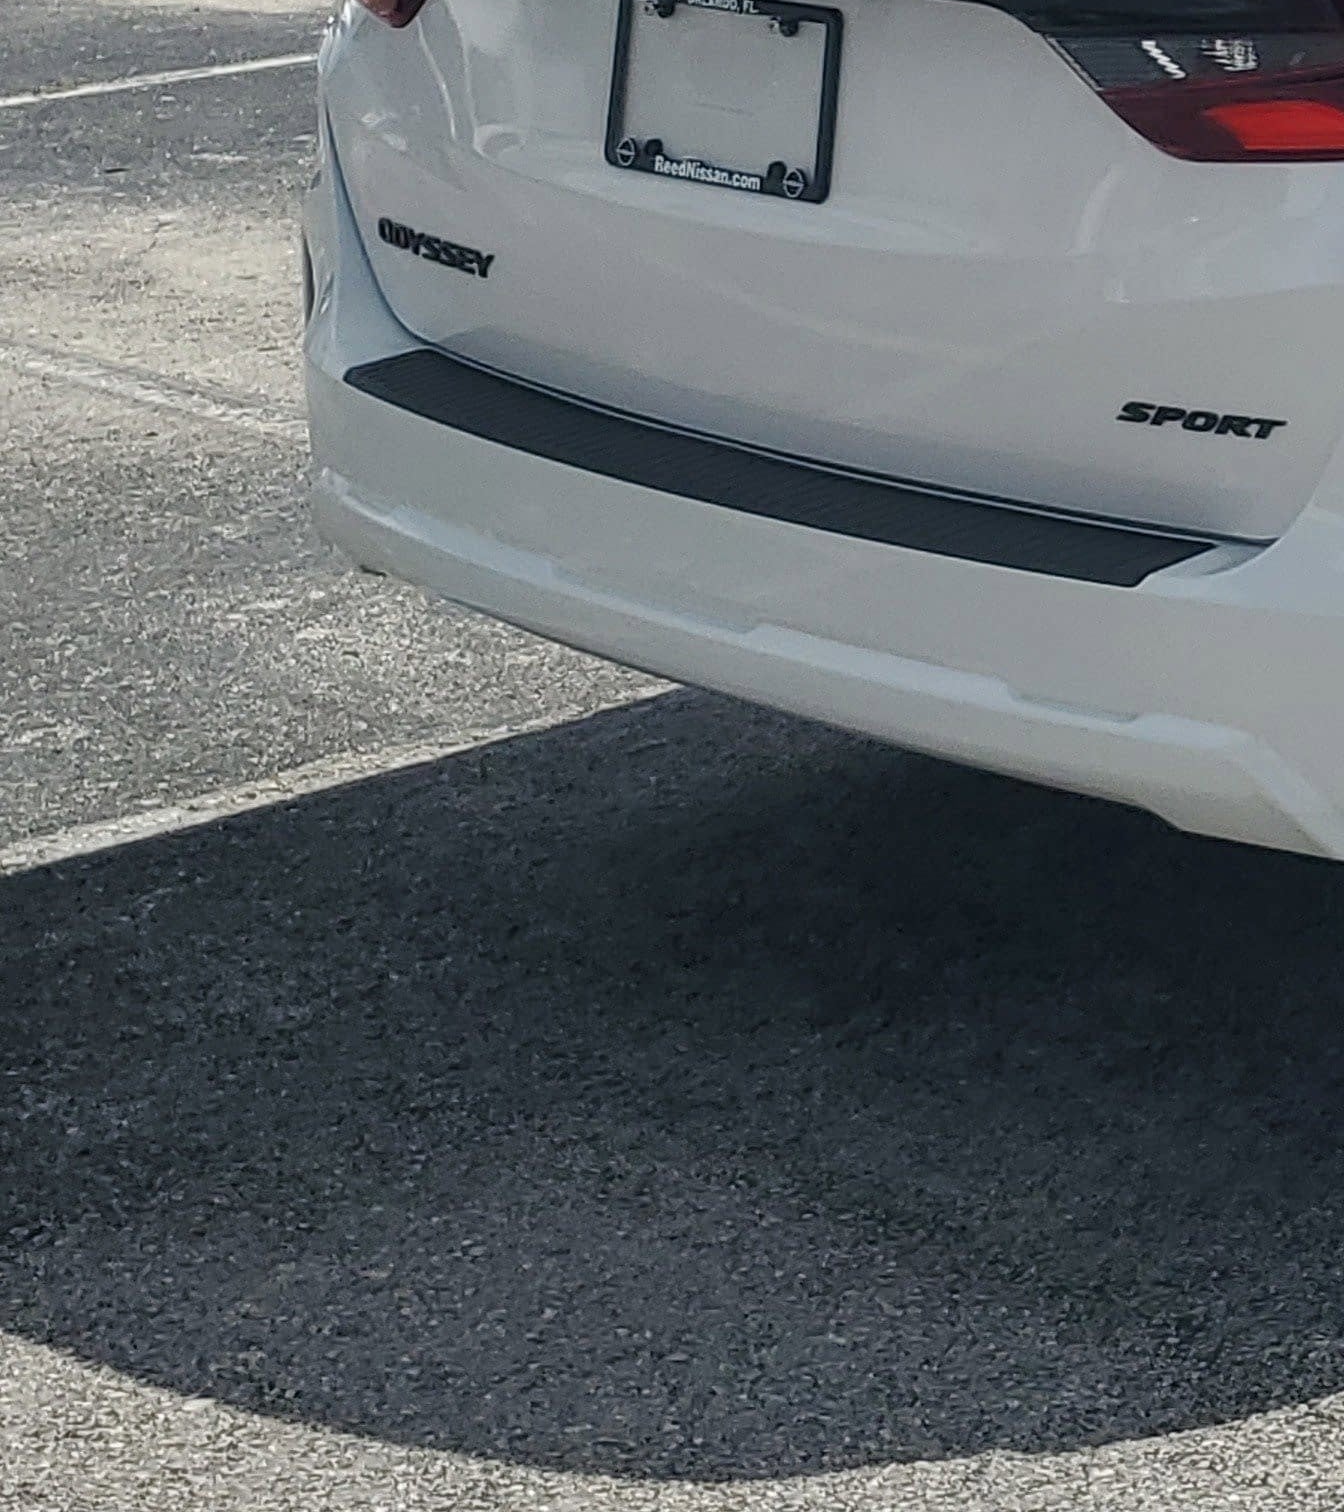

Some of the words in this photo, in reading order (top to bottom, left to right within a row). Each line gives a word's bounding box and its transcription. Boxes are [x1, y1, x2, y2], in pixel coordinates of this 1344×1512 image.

[742, 0, 760, 14] FL
[653, 154, 761, 191] ReedNissan.com
[377, 217, 496, 279] ODYSSEY
[1115, 400, 1289, 440] SPORT
